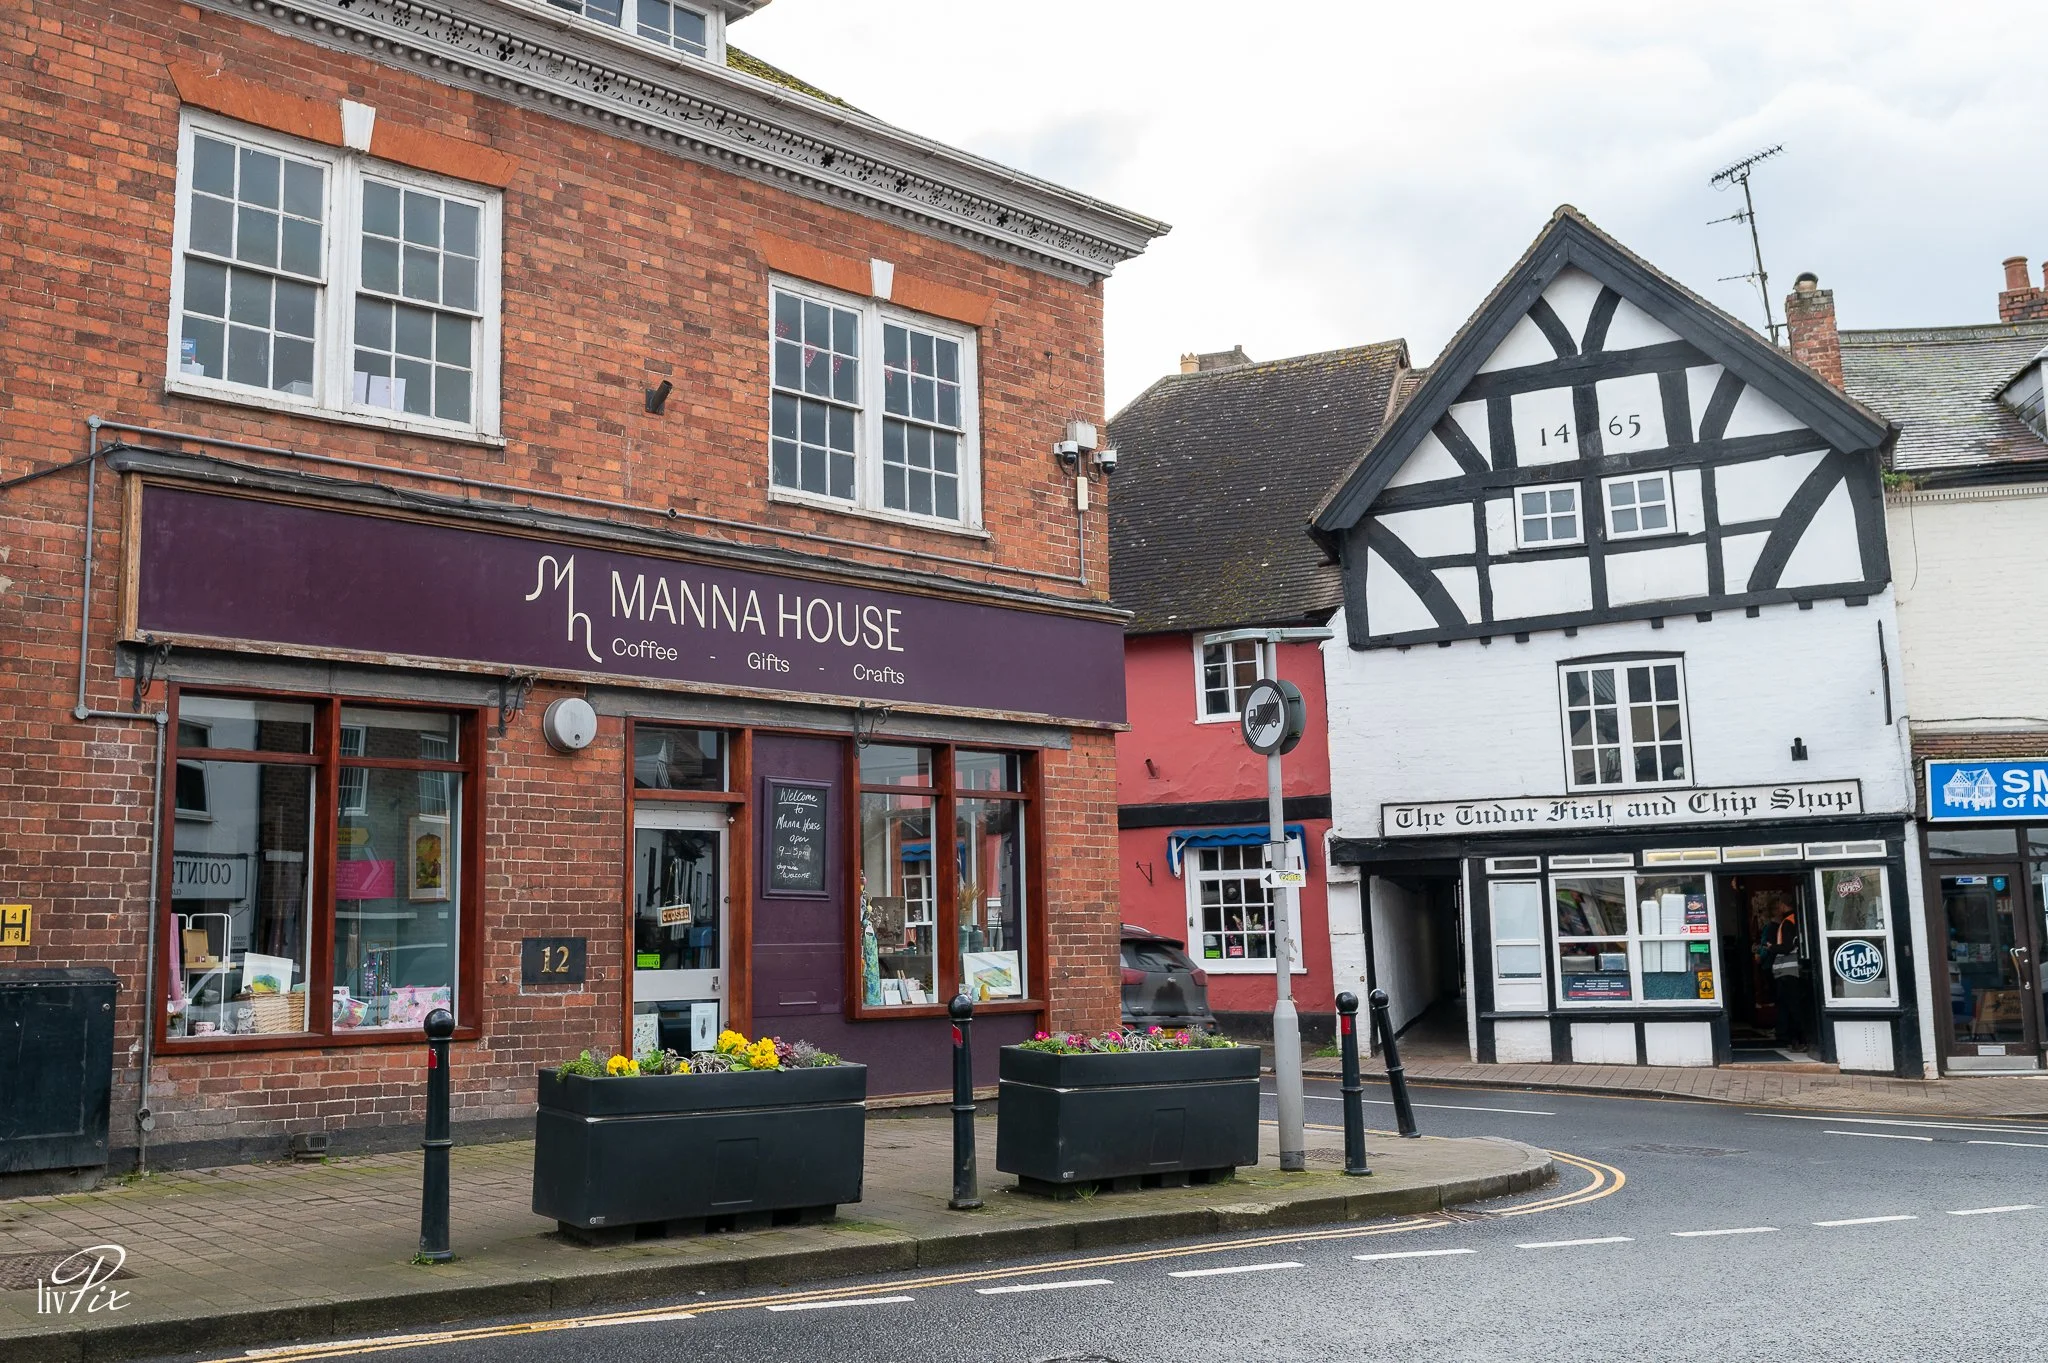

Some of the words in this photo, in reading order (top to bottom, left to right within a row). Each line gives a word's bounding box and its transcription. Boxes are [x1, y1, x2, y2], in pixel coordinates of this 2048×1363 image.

[1540, 424, 1570, 446] 14
[1609, 414, 1641, 438] 65
[612, 570, 766, 636] MANNA
[778, 593, 904, 652] HOUSE
[612, 637, 678, 661] Coffee
[747, 652, 790, 673] Gifts
[853, 663, 905, 684] Crafts
[780, 787, 817, 802] Welcome
[2002, 794, 2027, 808] of
[794, 803, 804, 814] to
[1396, 807, 1445, 831] The
[1455, 804, 1538, 826] Tudor
[1546, 799, 1612, 823] Fish
[1627, 795, 1676, 818] and
[1688, 791, 1757, 817] Chip
[1770, 787, 1853, 813] Shop
[776, 814, 800, 830] Manna
[802, 818, 821, 832] House
[11, 912, 17, 920] 4
[662, 908, 689, 922] CLOSED
[541, 946, 569, 973] 12
[1838, 947, 1880, 970] Fish
[1851, 965, 1877, 978] Chips
